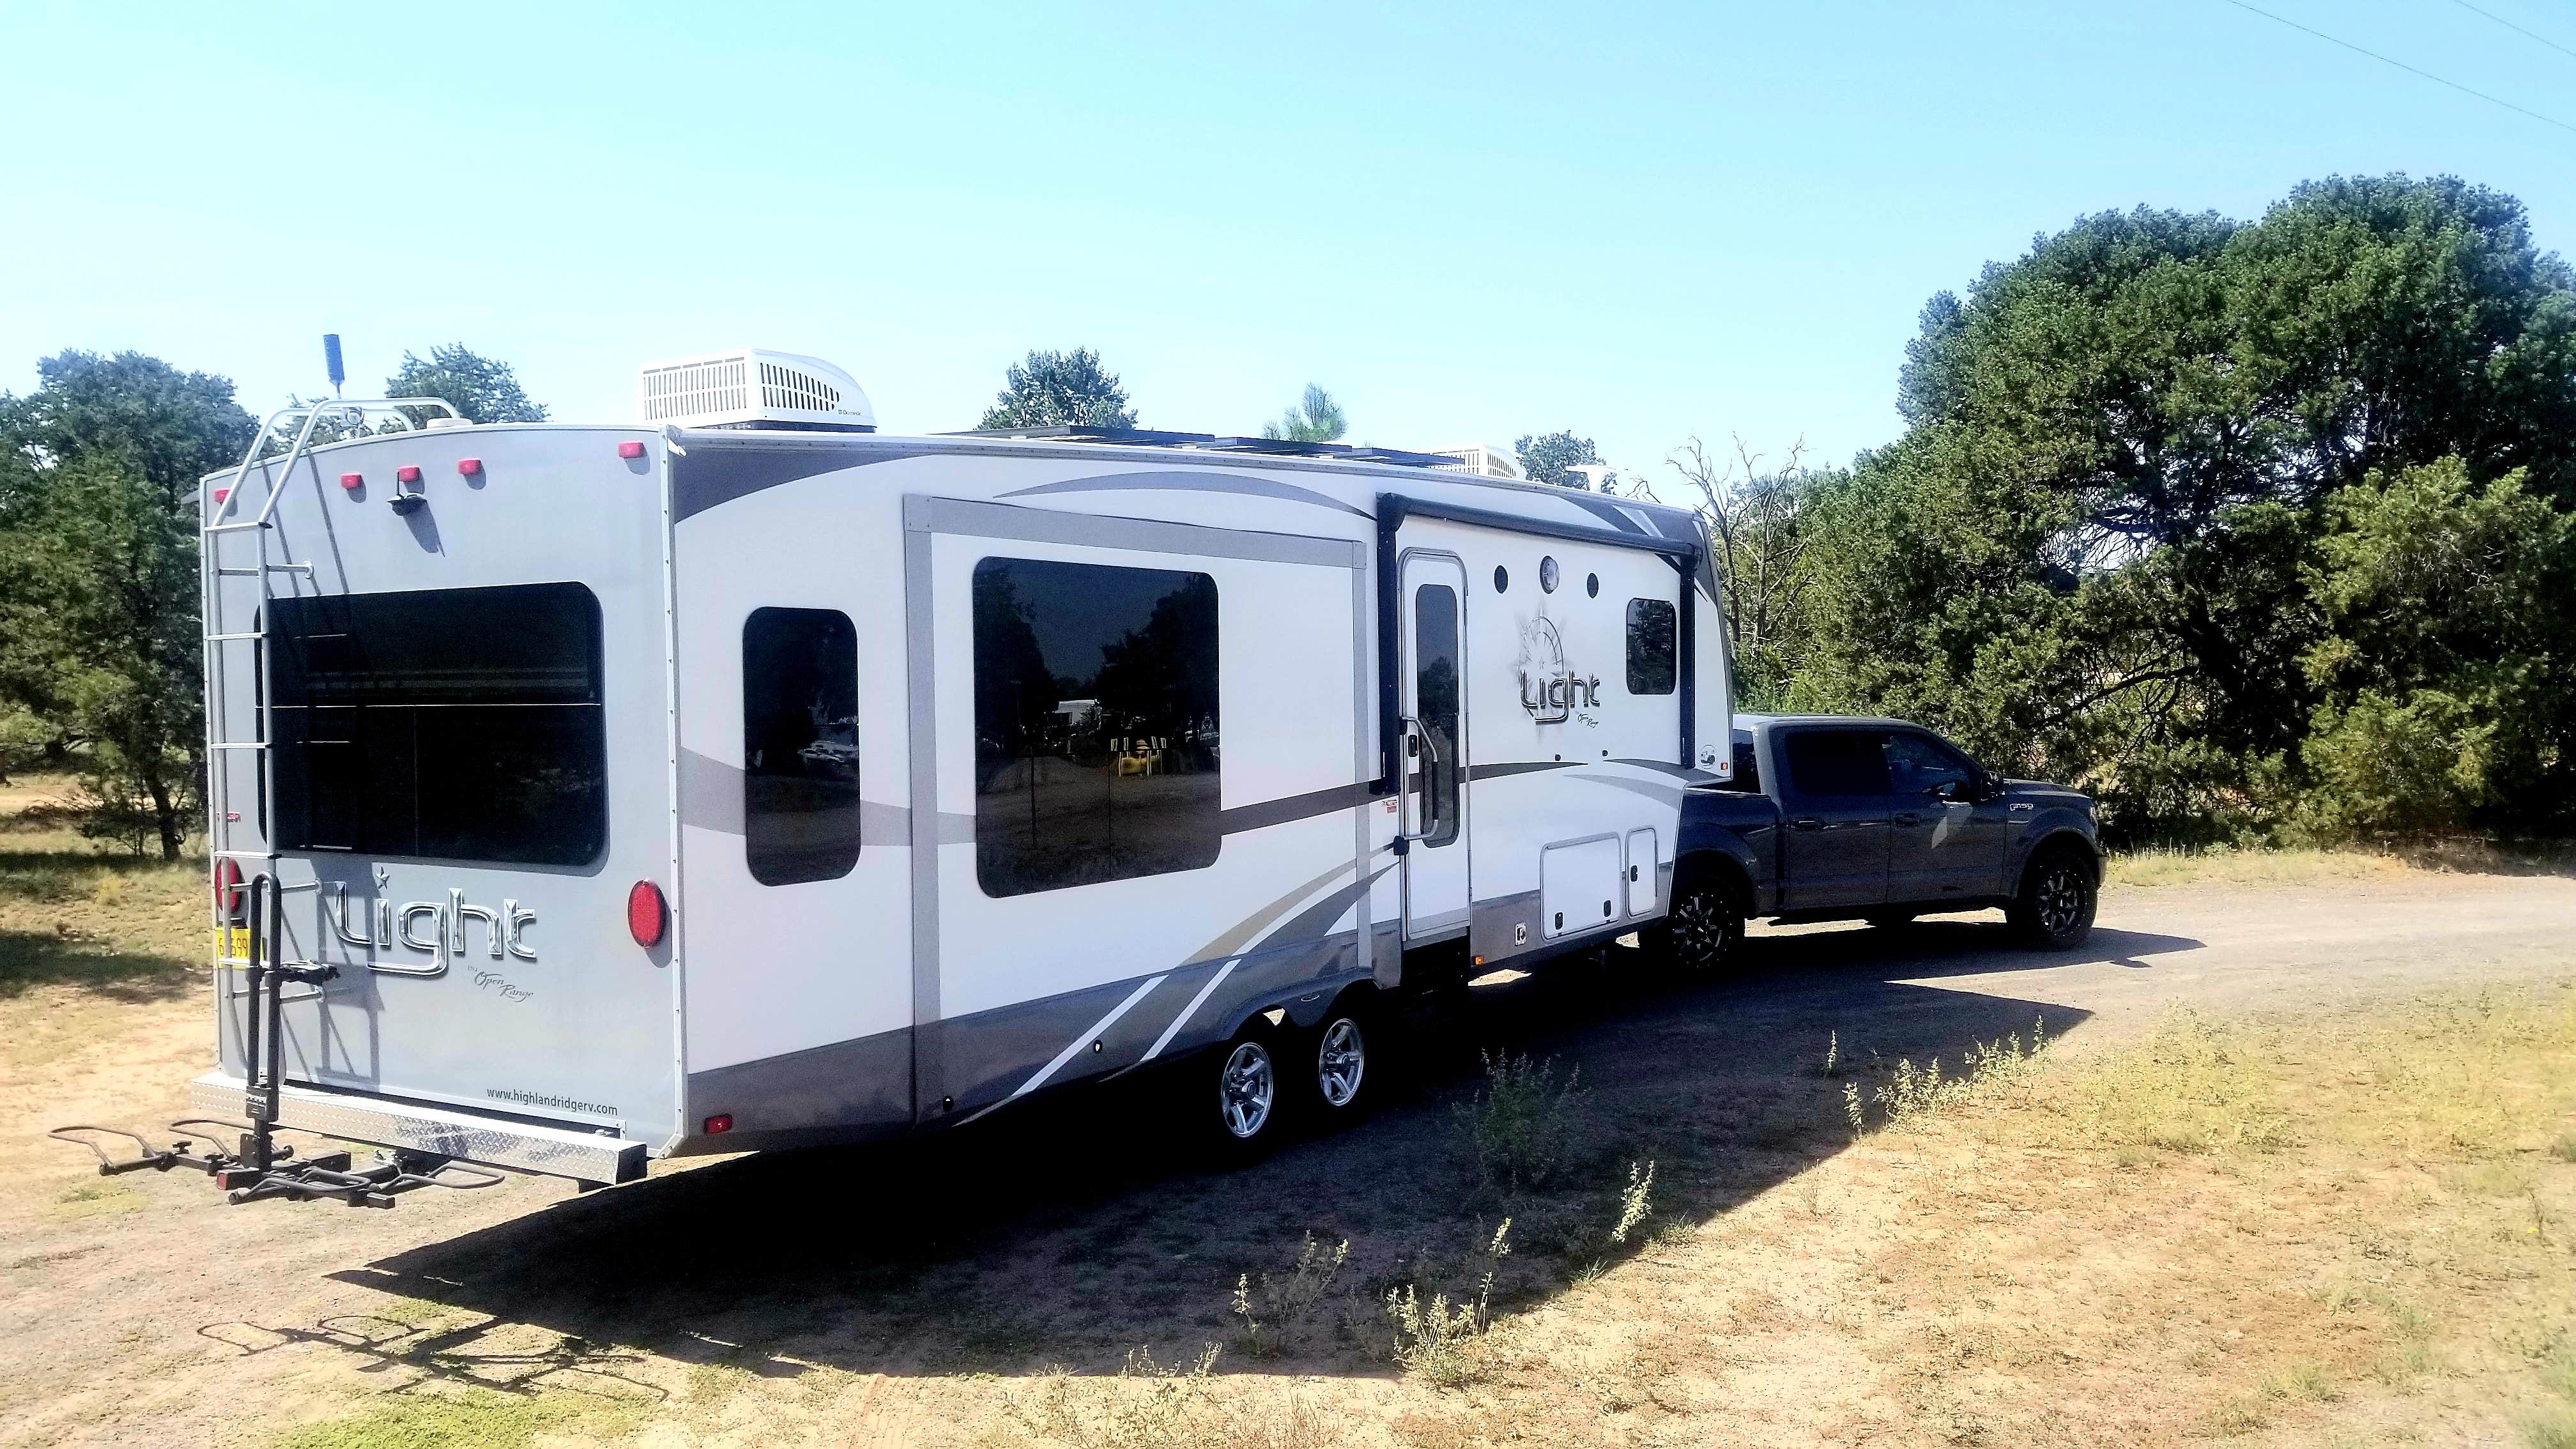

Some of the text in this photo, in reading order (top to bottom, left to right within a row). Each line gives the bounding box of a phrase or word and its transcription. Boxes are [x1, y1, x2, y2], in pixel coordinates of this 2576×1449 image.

[1520, 661, 1600, 724] Light
[335, 867, 537, 976] Light
[474, 971, 504, 990] Open
[487, 1088, 618, 1116] www.highlandridgerv.com
